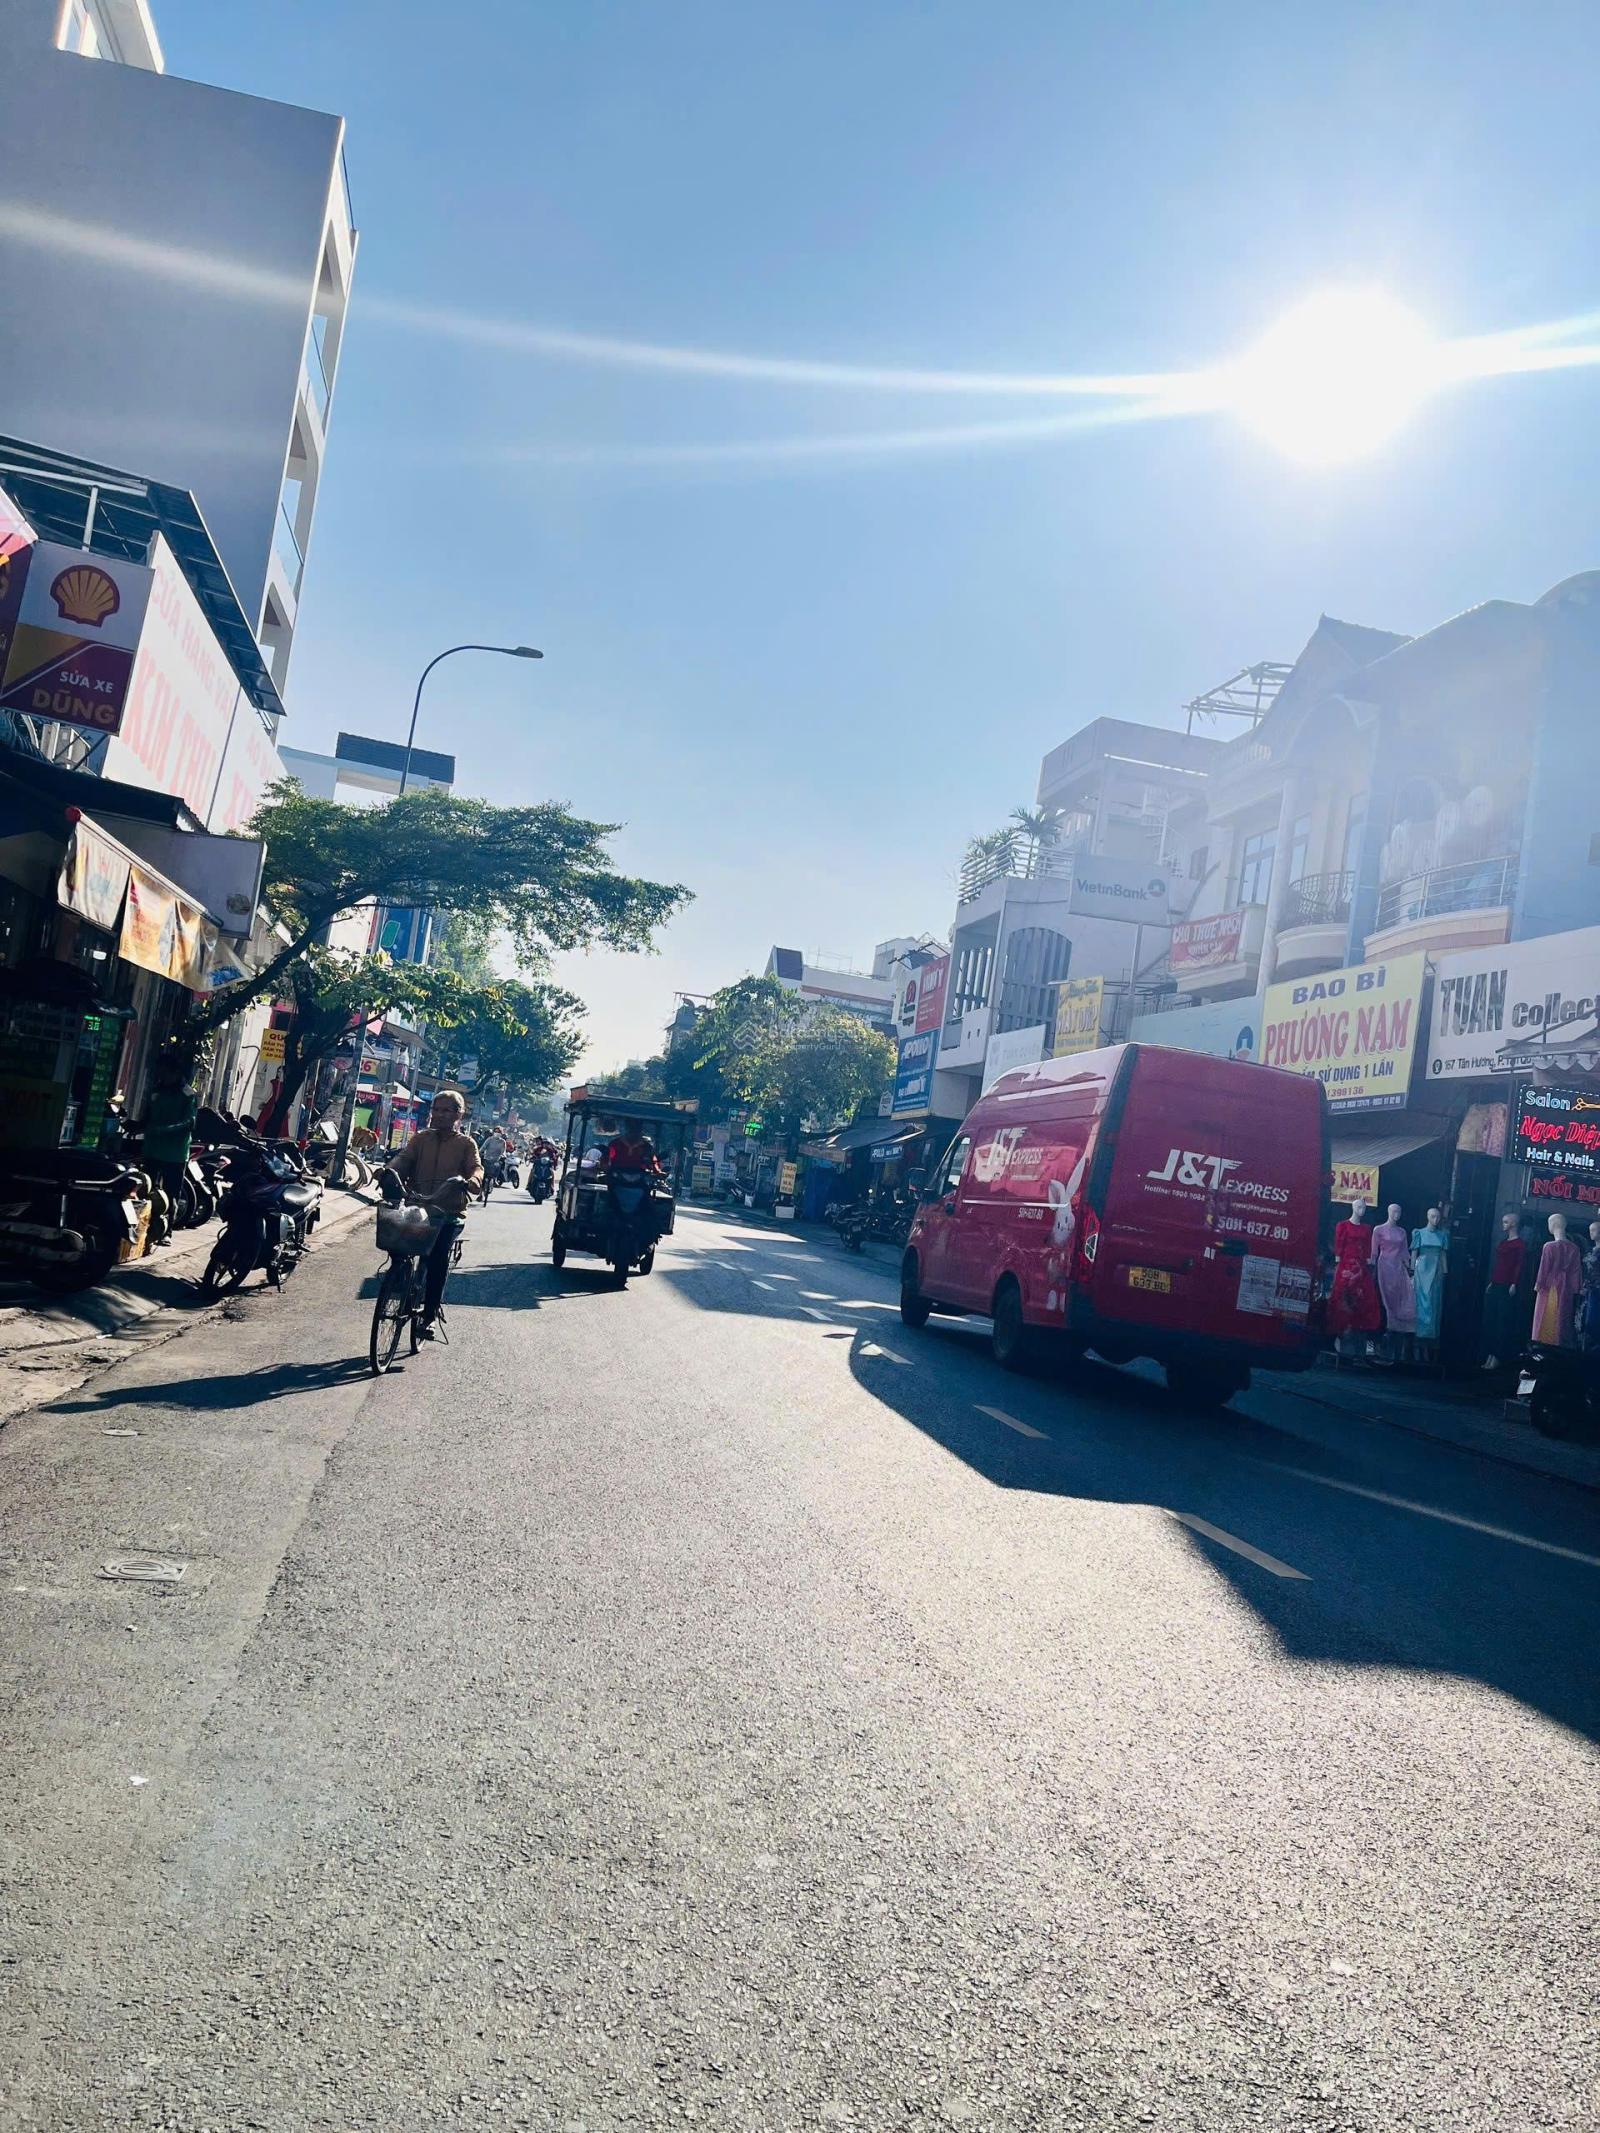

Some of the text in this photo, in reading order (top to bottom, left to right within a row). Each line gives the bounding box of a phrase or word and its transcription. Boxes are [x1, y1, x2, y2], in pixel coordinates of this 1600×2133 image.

[59, 669, 113, 694] SỬA XE
[32, 688, 116, 725] DŨNG
[1076, 878, 1147, 901] VietinBank
[1292, 966, 1386, 1005] BAO BÌ
[1440, 970, 1508, 1037] TUAN
[1264, 998, 1412, 1067] PHƯƠNG NAM
[1333, 1067, 1360, 1085] DỤNG
[1364, 1064, 1369, 1078] 1
[1525, 1090, 1571, 1111] Salon
[1520, 1115, 1564, 1145] Ngọc
[1011, 1148, 1043, 1165] EXPRESS
[1526, 1147, 1594, 1167] Hair & Nails
[1146, 1148, 1290, 1203] J&T EXPRESS
[1340, 1171, 1372, 1191] NAM
[1217, 1215, 1289, 1240] 50H-637.80
